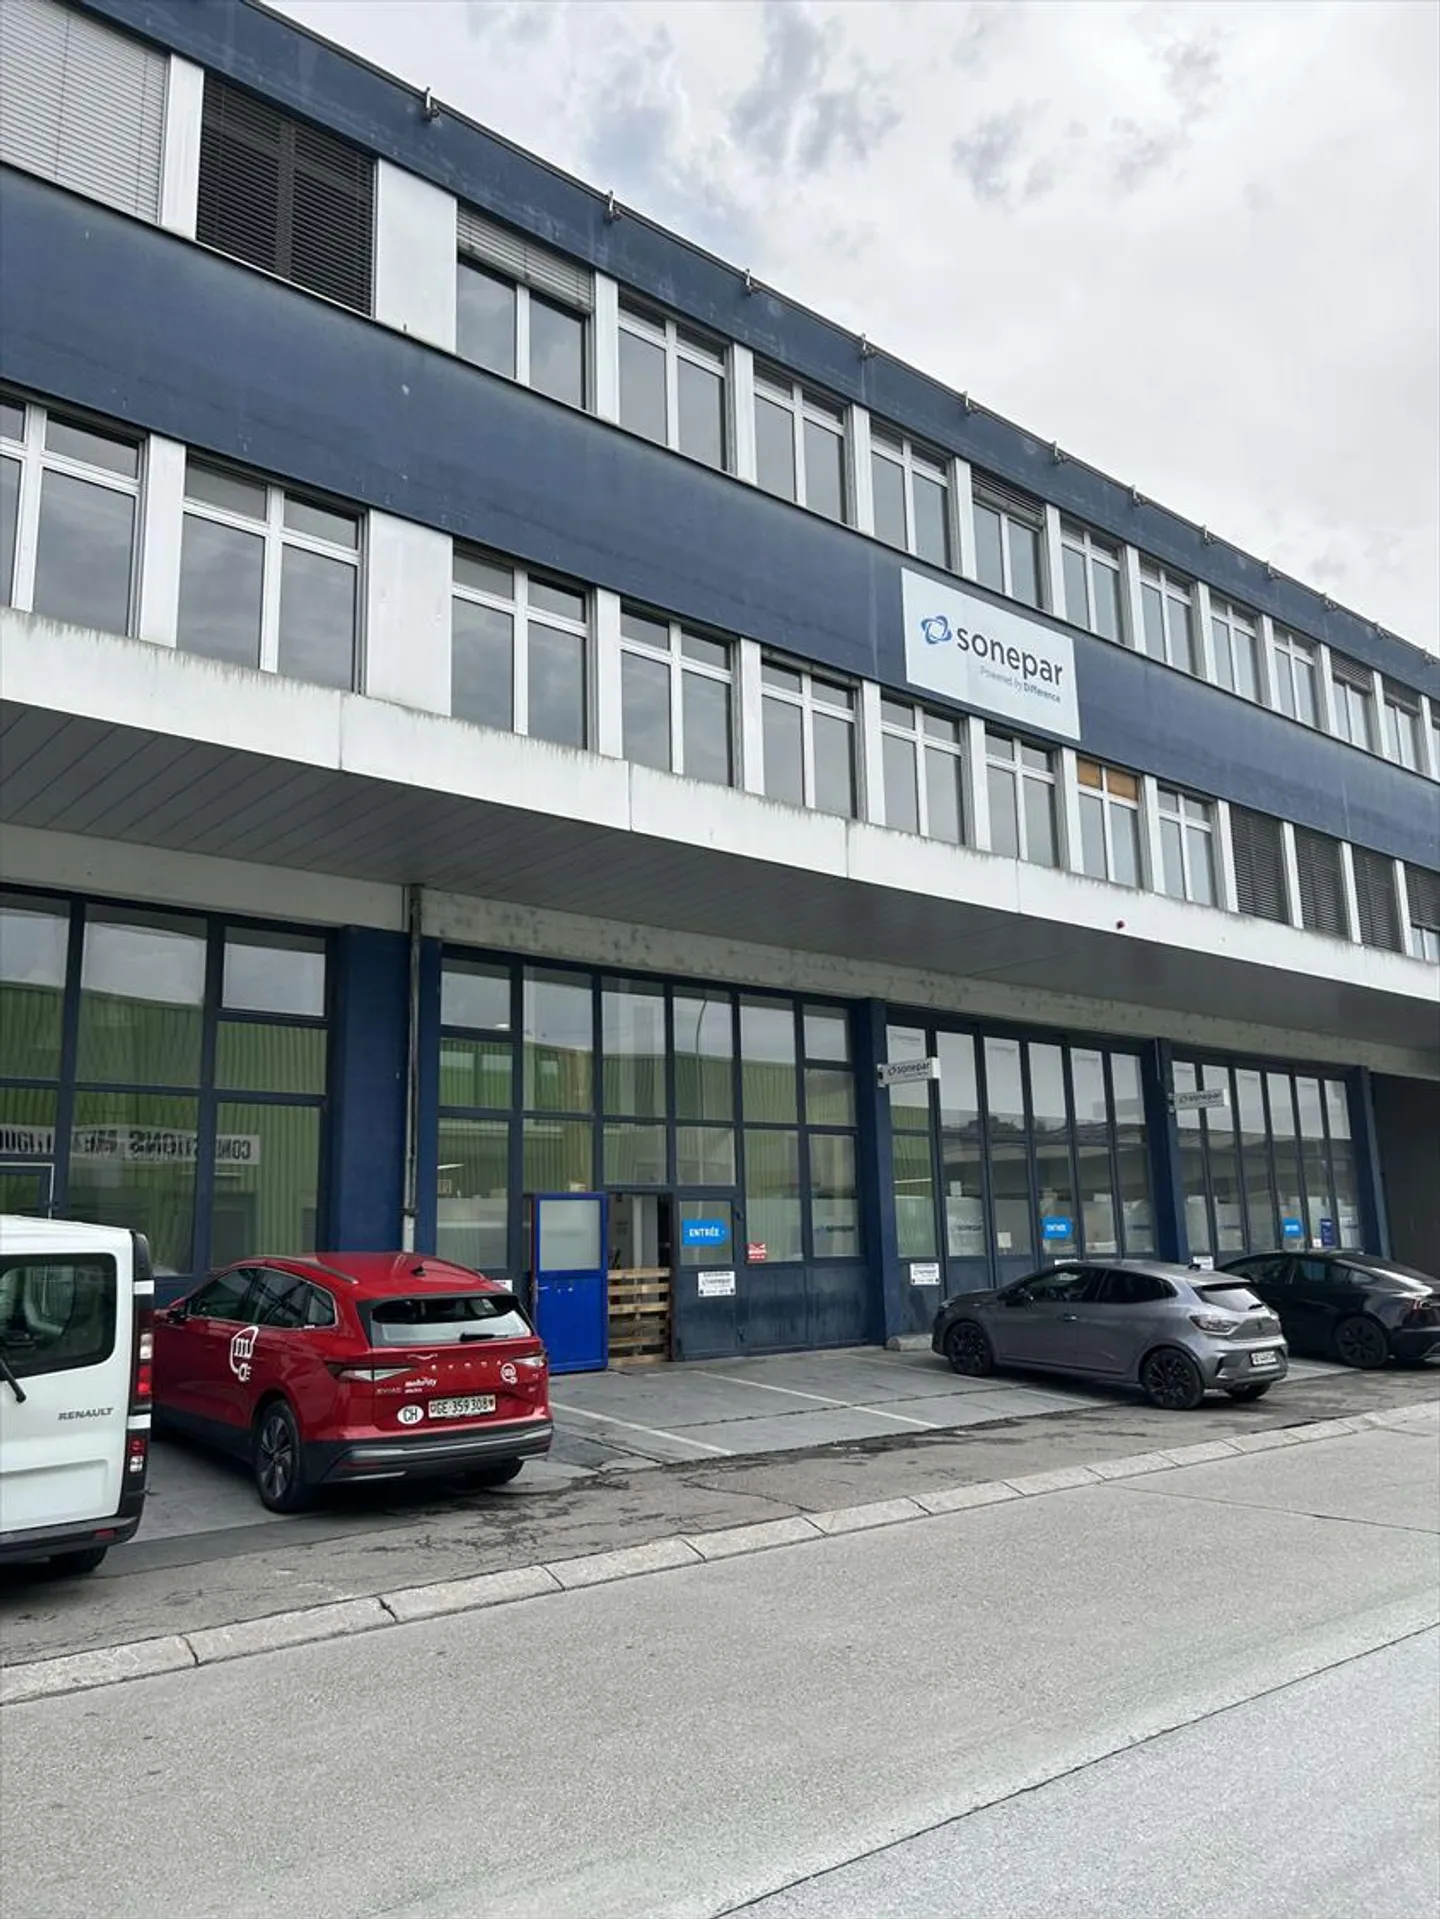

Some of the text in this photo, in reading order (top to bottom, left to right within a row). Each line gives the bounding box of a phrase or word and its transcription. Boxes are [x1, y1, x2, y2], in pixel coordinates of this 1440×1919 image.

[957, 627, 1063, 686] sonepar
[1024, 682, 1061, 704] Difference
[689, 1225, 721, 1238] ENTRÉE
[57, 1406, 114, 1421] RENAULT
[403, 1407, 418, 1422] CH
